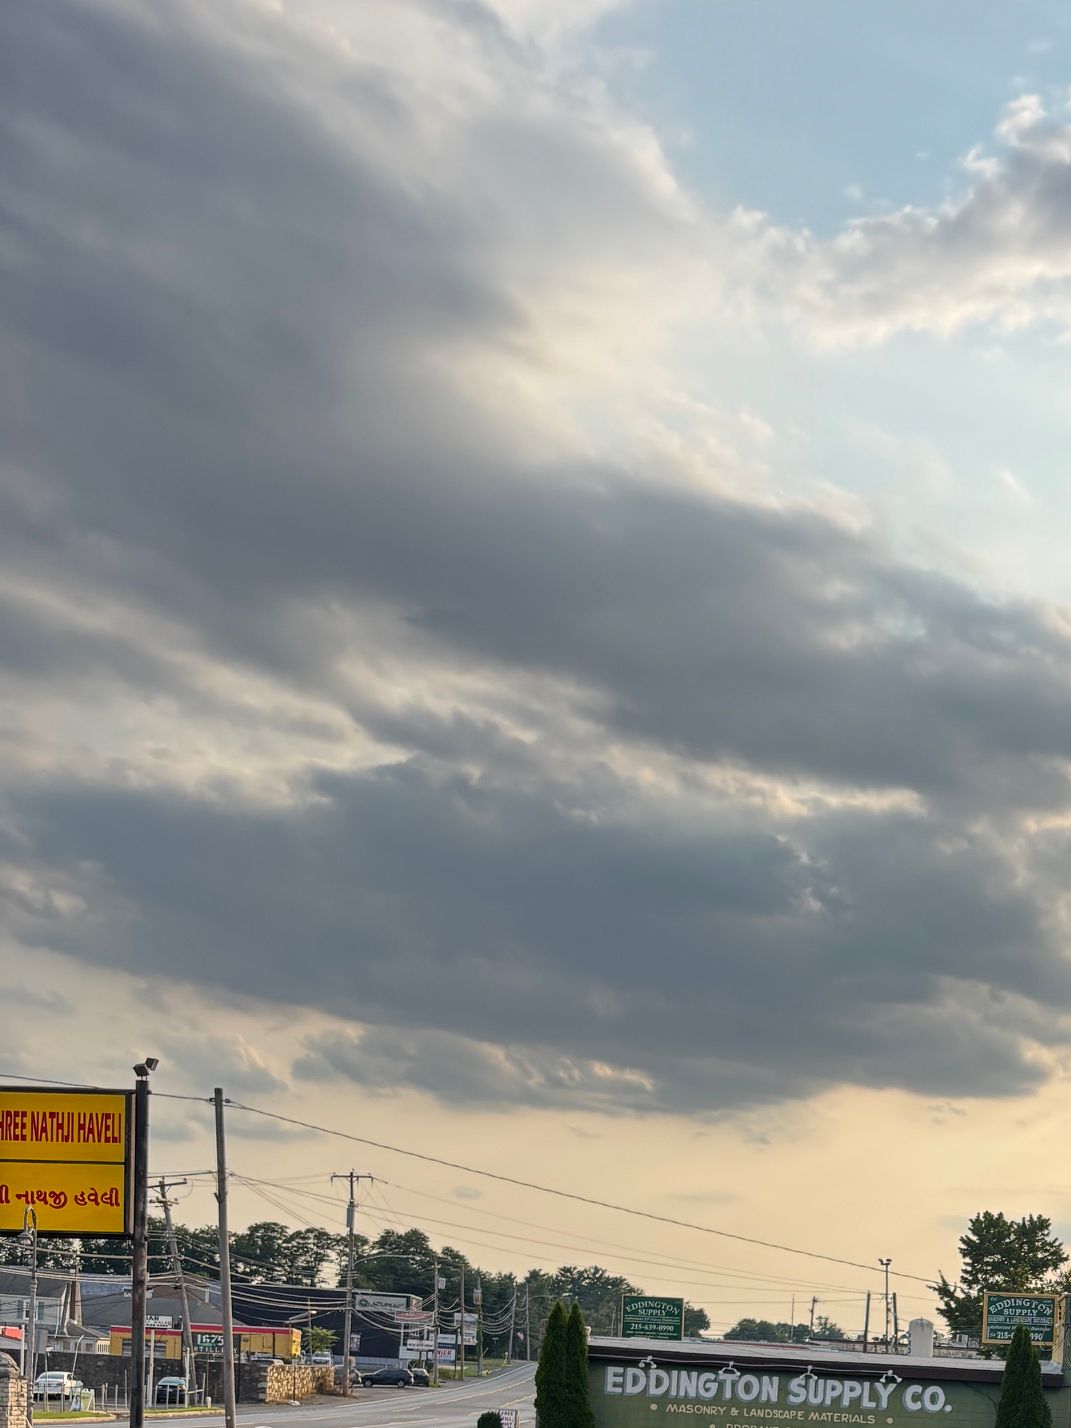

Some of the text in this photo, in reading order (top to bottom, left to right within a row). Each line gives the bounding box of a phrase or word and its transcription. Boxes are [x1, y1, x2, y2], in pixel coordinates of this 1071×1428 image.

[31, 1111, 74, 1143] NATHJI
[78, 1112, 121, 1143] HAVELI
[16, 1189, 67, 1209] નાથજી
[74, 1187, 120, 1207] હવેલી
[625, 1300, 680, 1315] EDDINGTON
[638, 1308, 667, 1316] SUPPLY
[989, 1299, 1053, 1316] EDDINGTON
[1003, 1308, 1038, 1317] SUPPLY
[630, 1323, 674, 1332] 215-639-0990
[604, 1366, 953, 1413] EDDINGTON SUPPLY CO.
[666, 1403, 876, 1424] MASONRY & LANDSCAPE MATERIALS
